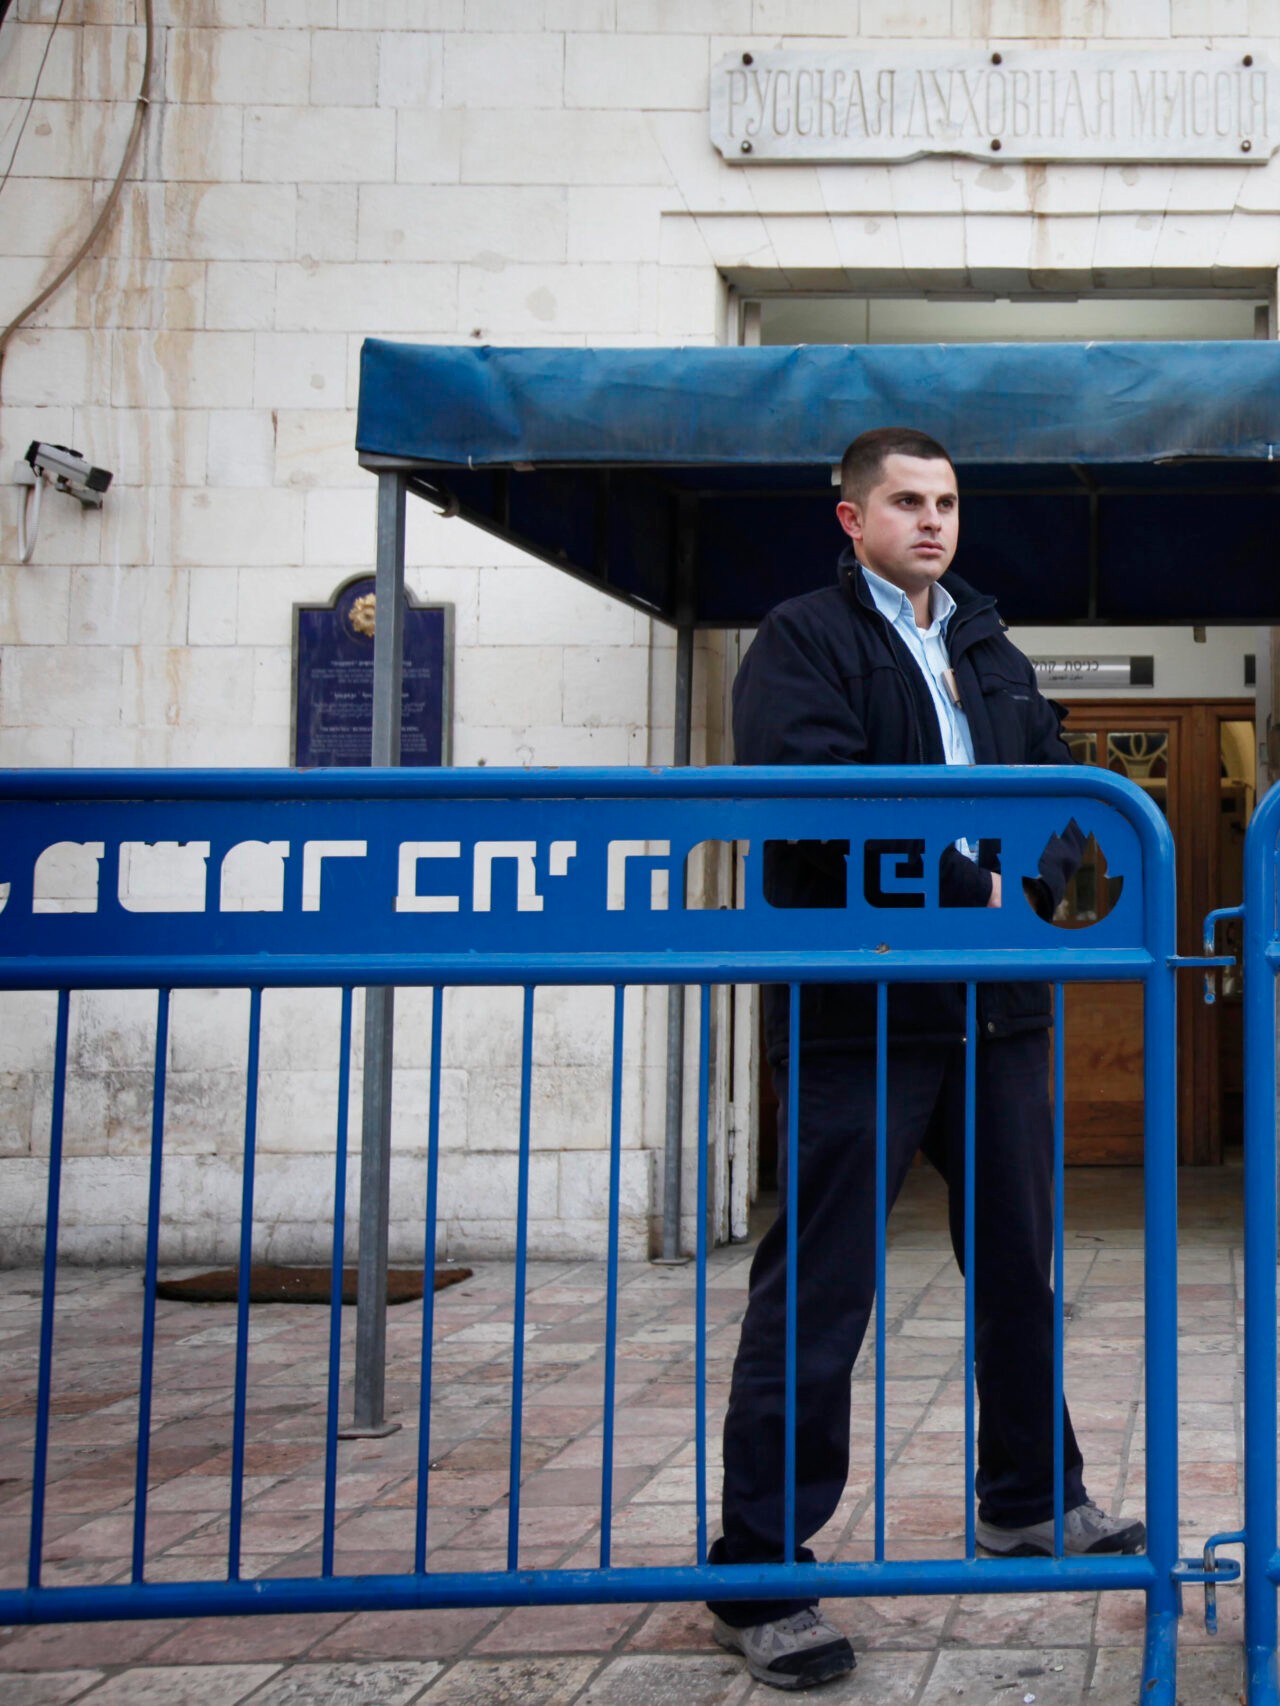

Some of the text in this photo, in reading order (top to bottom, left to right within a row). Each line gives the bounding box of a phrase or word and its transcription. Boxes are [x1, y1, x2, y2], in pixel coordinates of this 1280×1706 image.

[726, 69, 895, 137] РУССКАЯ
[904, 70, 1116, 138] ДУХОВНАЯ
[1064, 660, 1099, 672] כניסת
